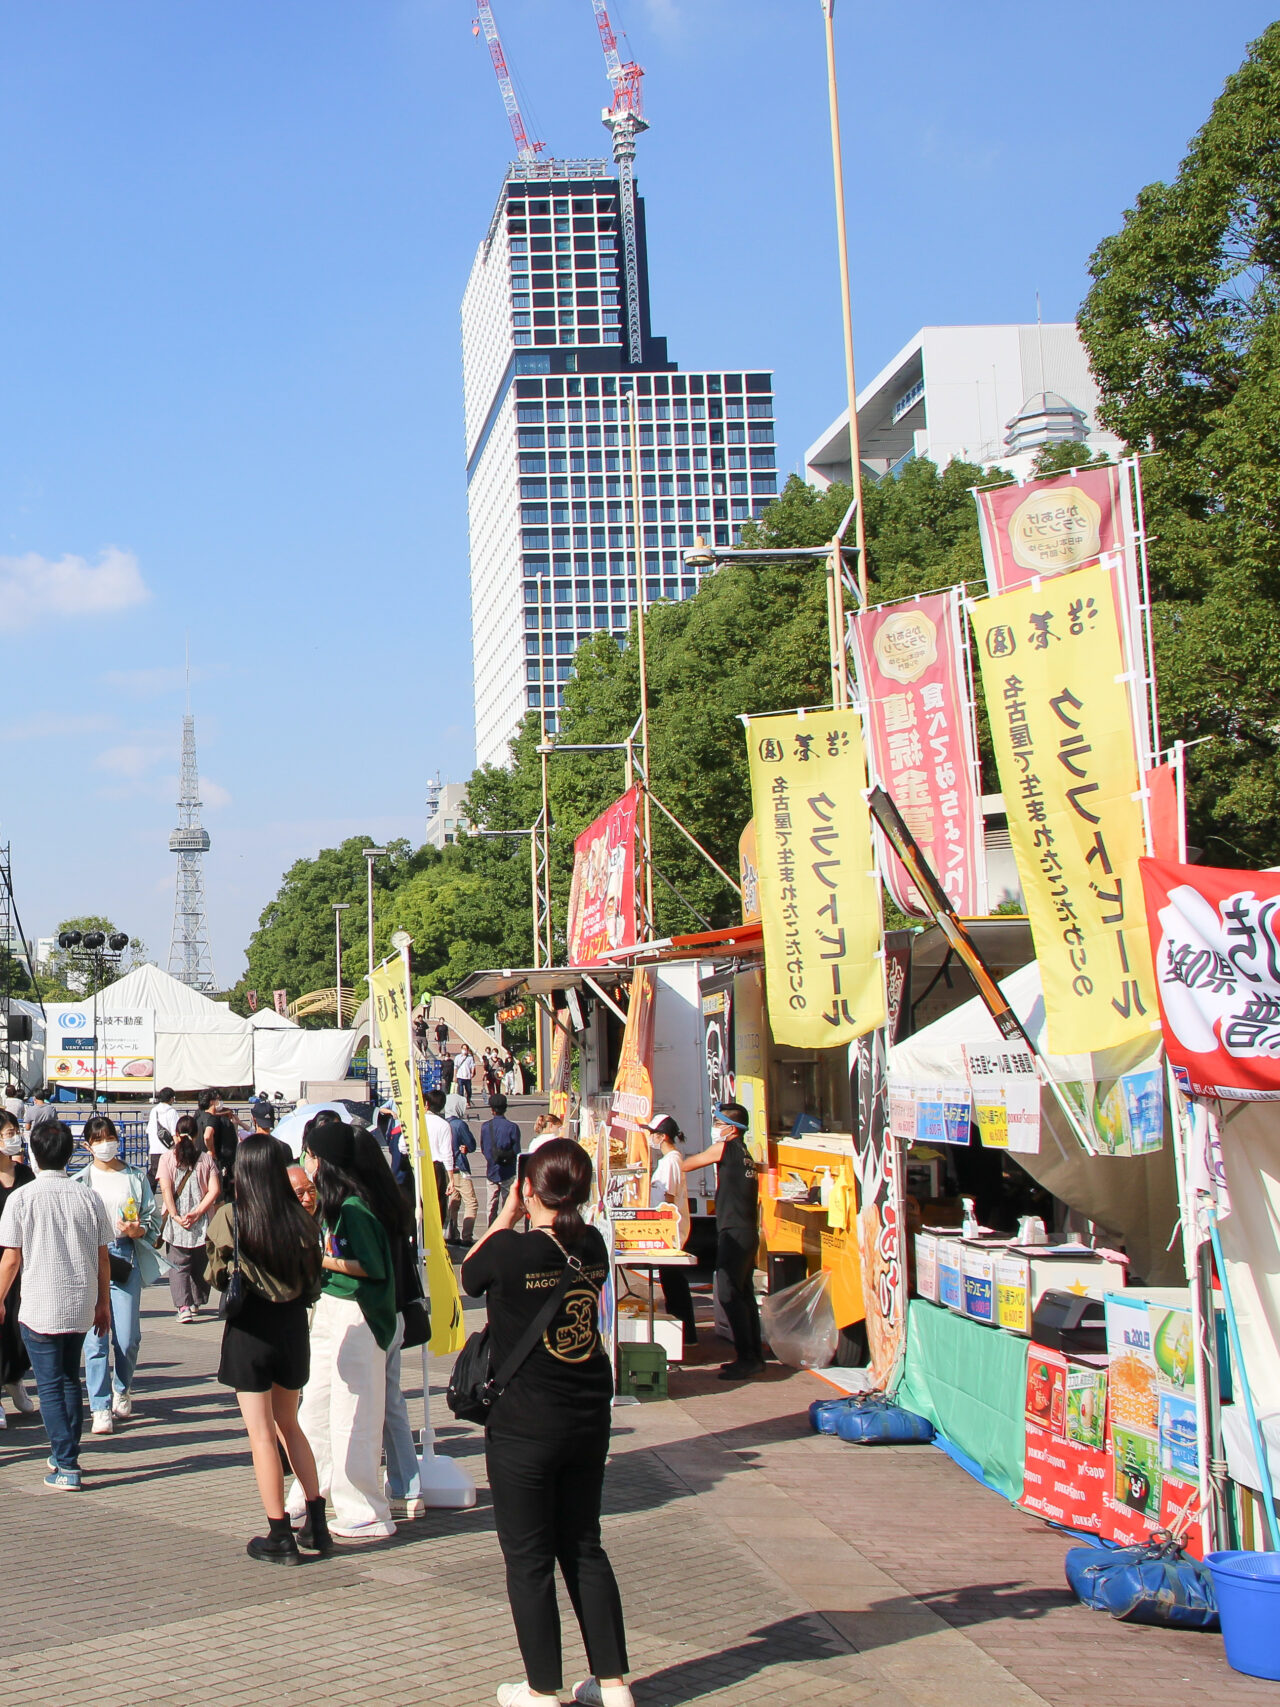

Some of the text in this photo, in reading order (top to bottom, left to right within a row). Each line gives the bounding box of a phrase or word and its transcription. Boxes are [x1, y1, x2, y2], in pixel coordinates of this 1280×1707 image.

[95, 1016, 143, 1026] 名岐不動産
